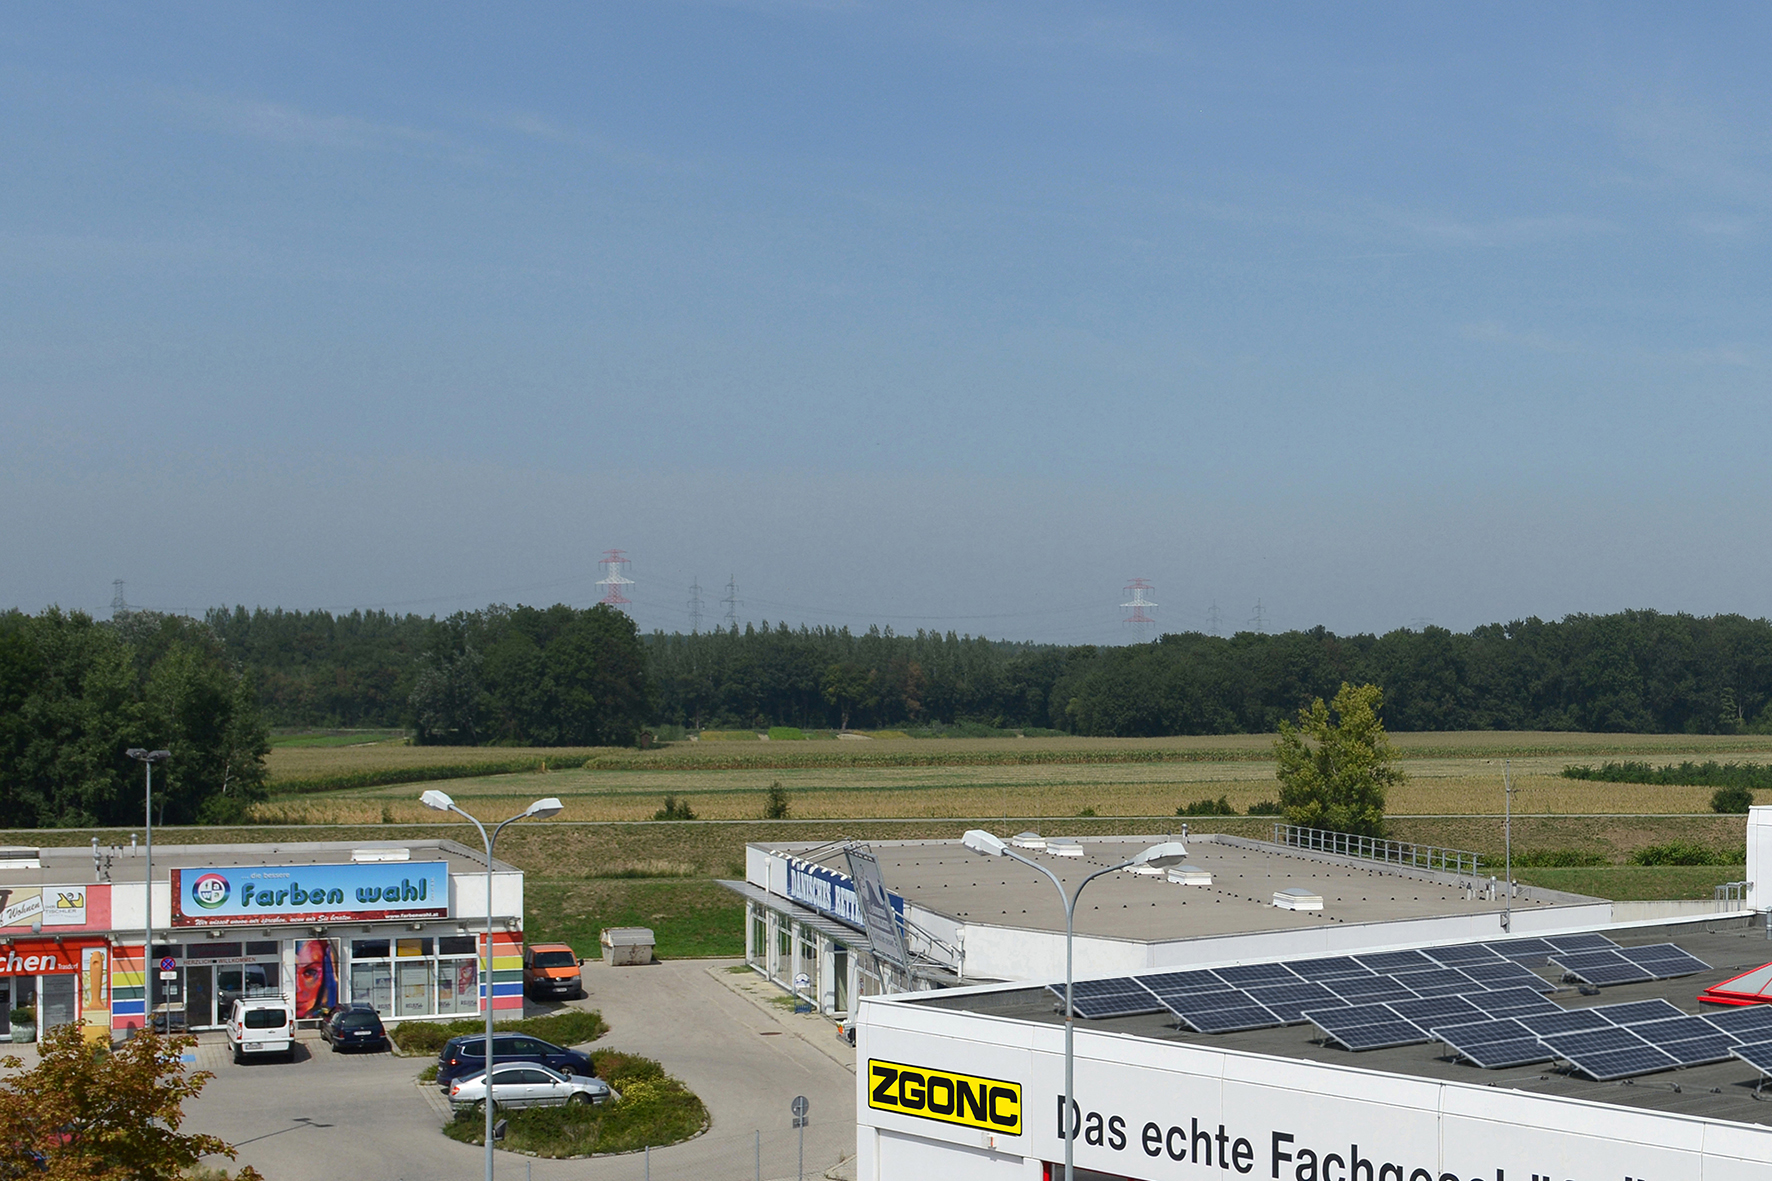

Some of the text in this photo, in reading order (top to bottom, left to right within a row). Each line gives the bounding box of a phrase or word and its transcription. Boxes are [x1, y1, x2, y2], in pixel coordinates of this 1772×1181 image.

[6, 901, 41, 919] Wohnen
[355, 878, 428, 904] wahl
[872, 1067, 1018, 1128] ZGONC
[1057, 1094, 1127, 1151] Das
[1141, 1117, 1254, 1174] echte
